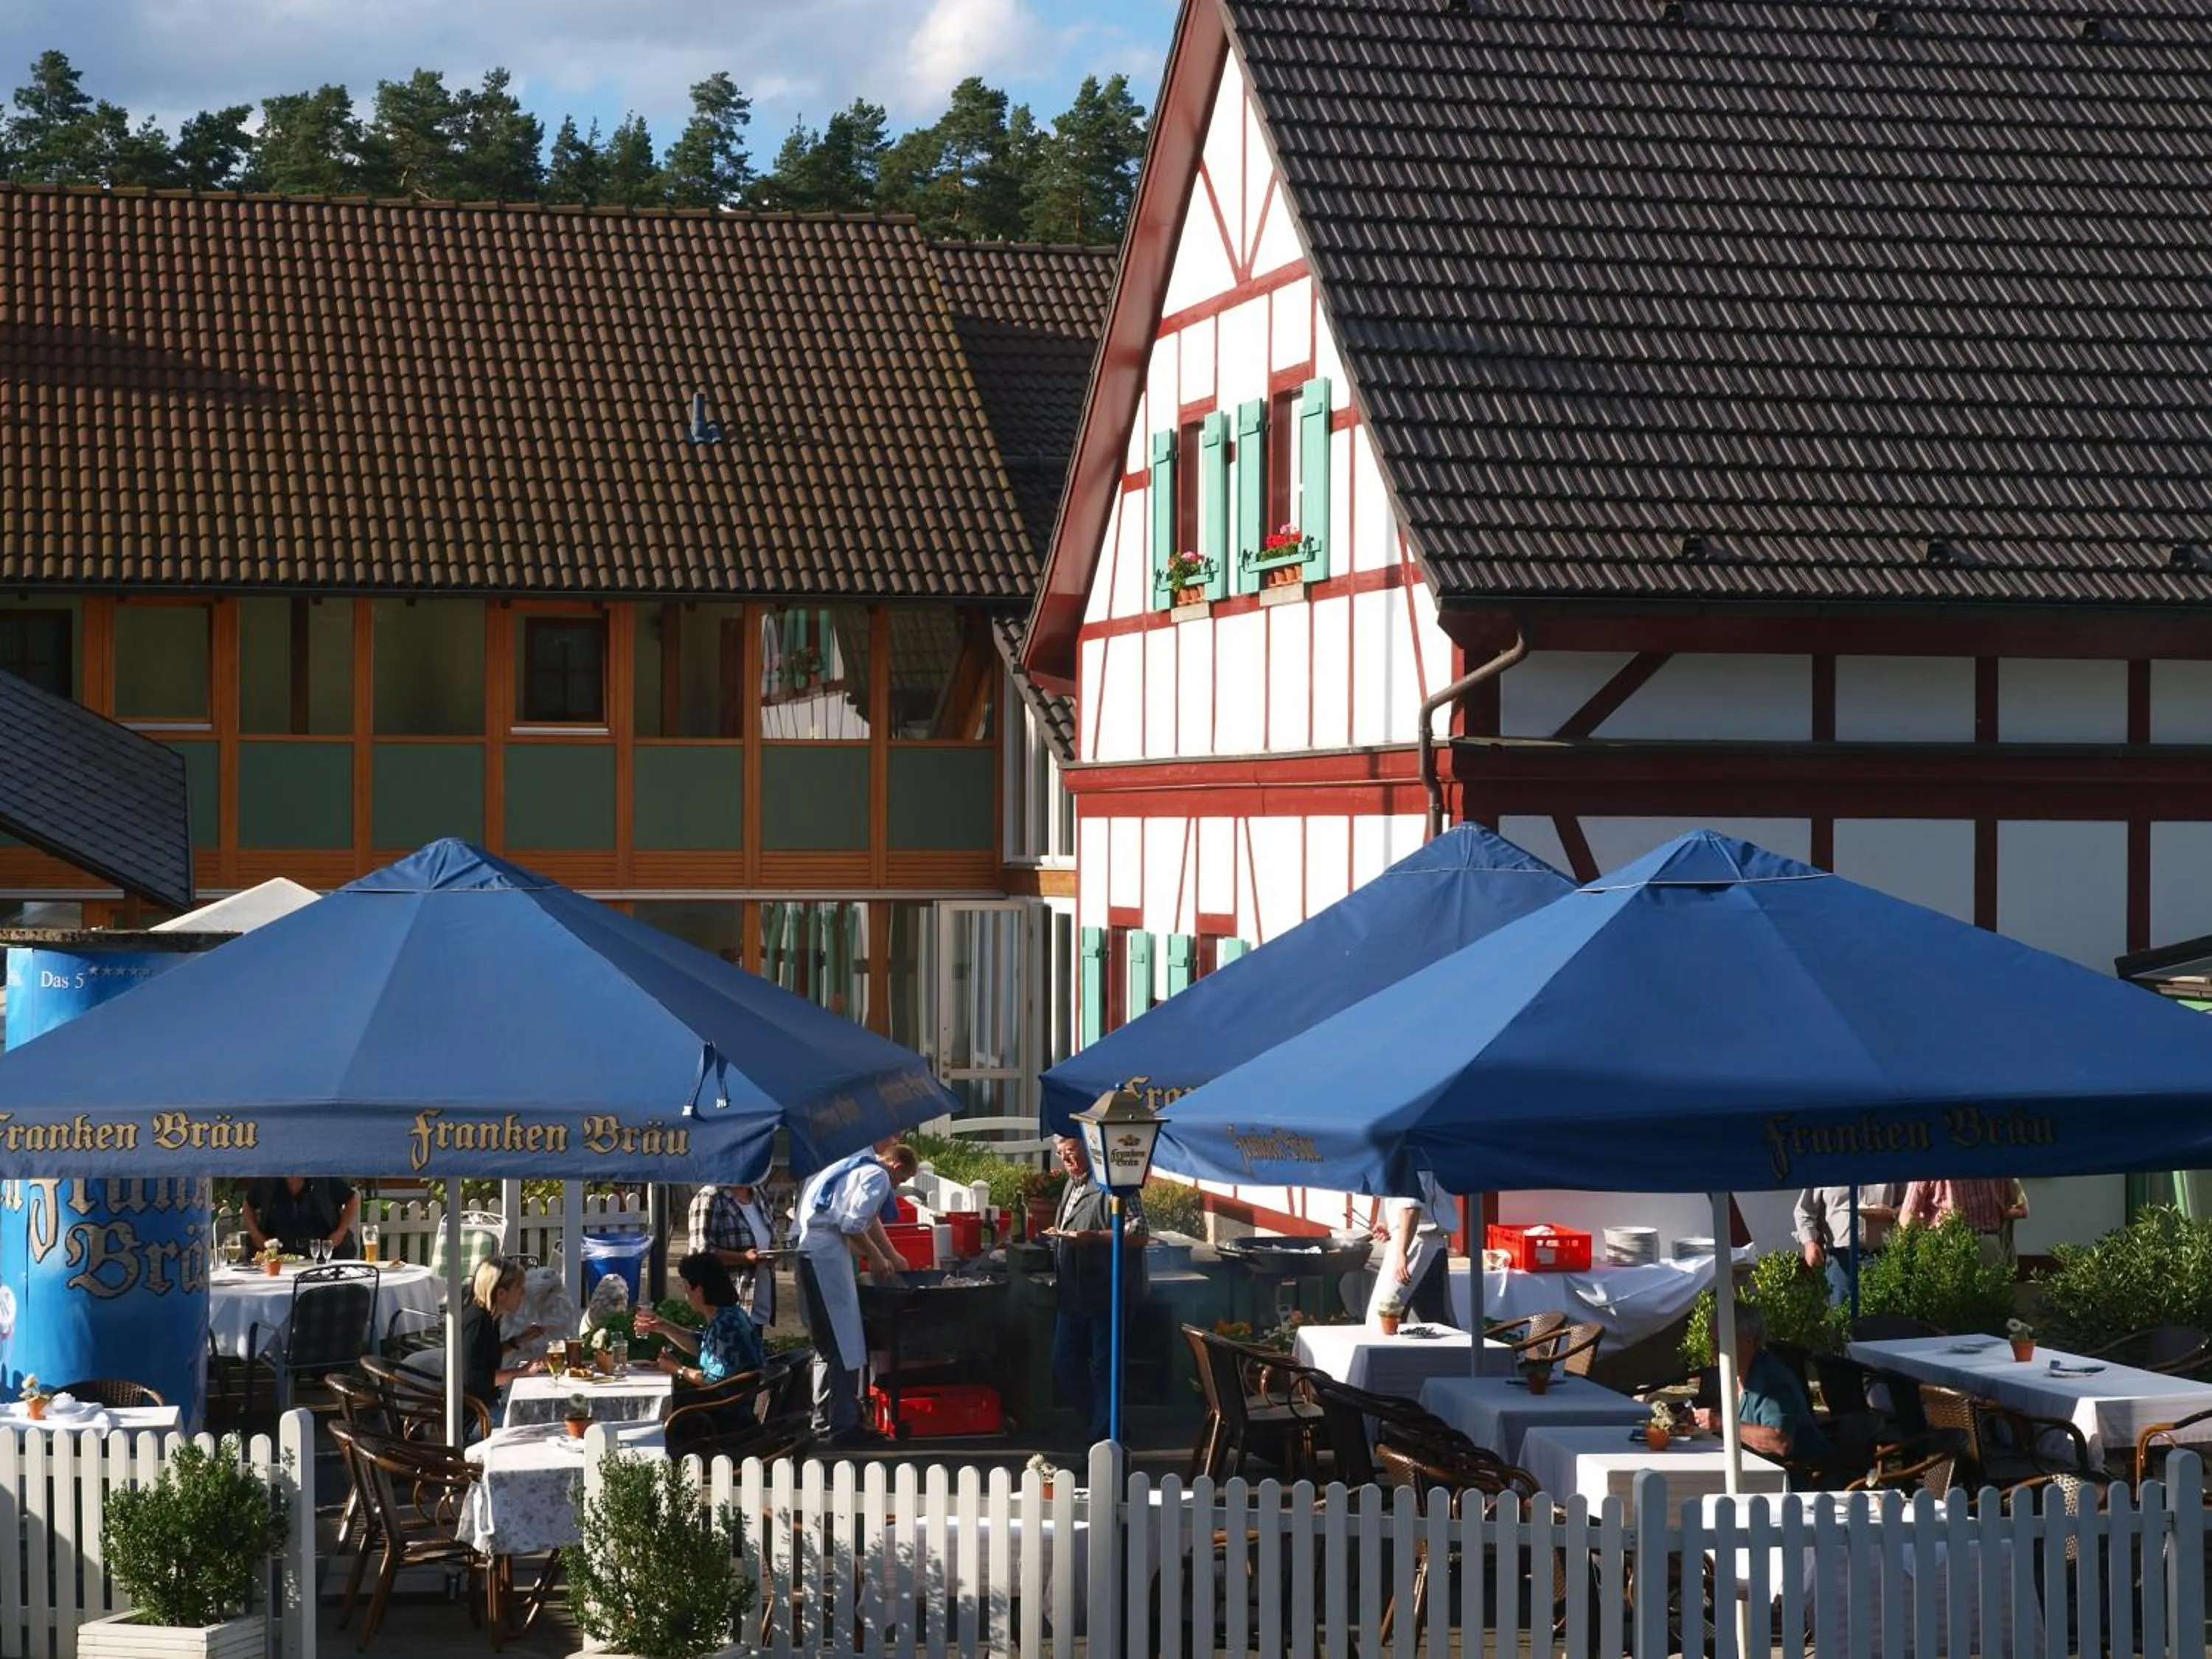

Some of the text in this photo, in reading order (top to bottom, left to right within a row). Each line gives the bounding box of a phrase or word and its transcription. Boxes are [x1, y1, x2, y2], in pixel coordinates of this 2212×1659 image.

[41, 970, 85, 990] Das 5
[153, 1110, 260, 1150] Bräu
[408, 1108, 692, 1172] Franken Bräu
[1763, 1108, 1933, 1180] Franken
